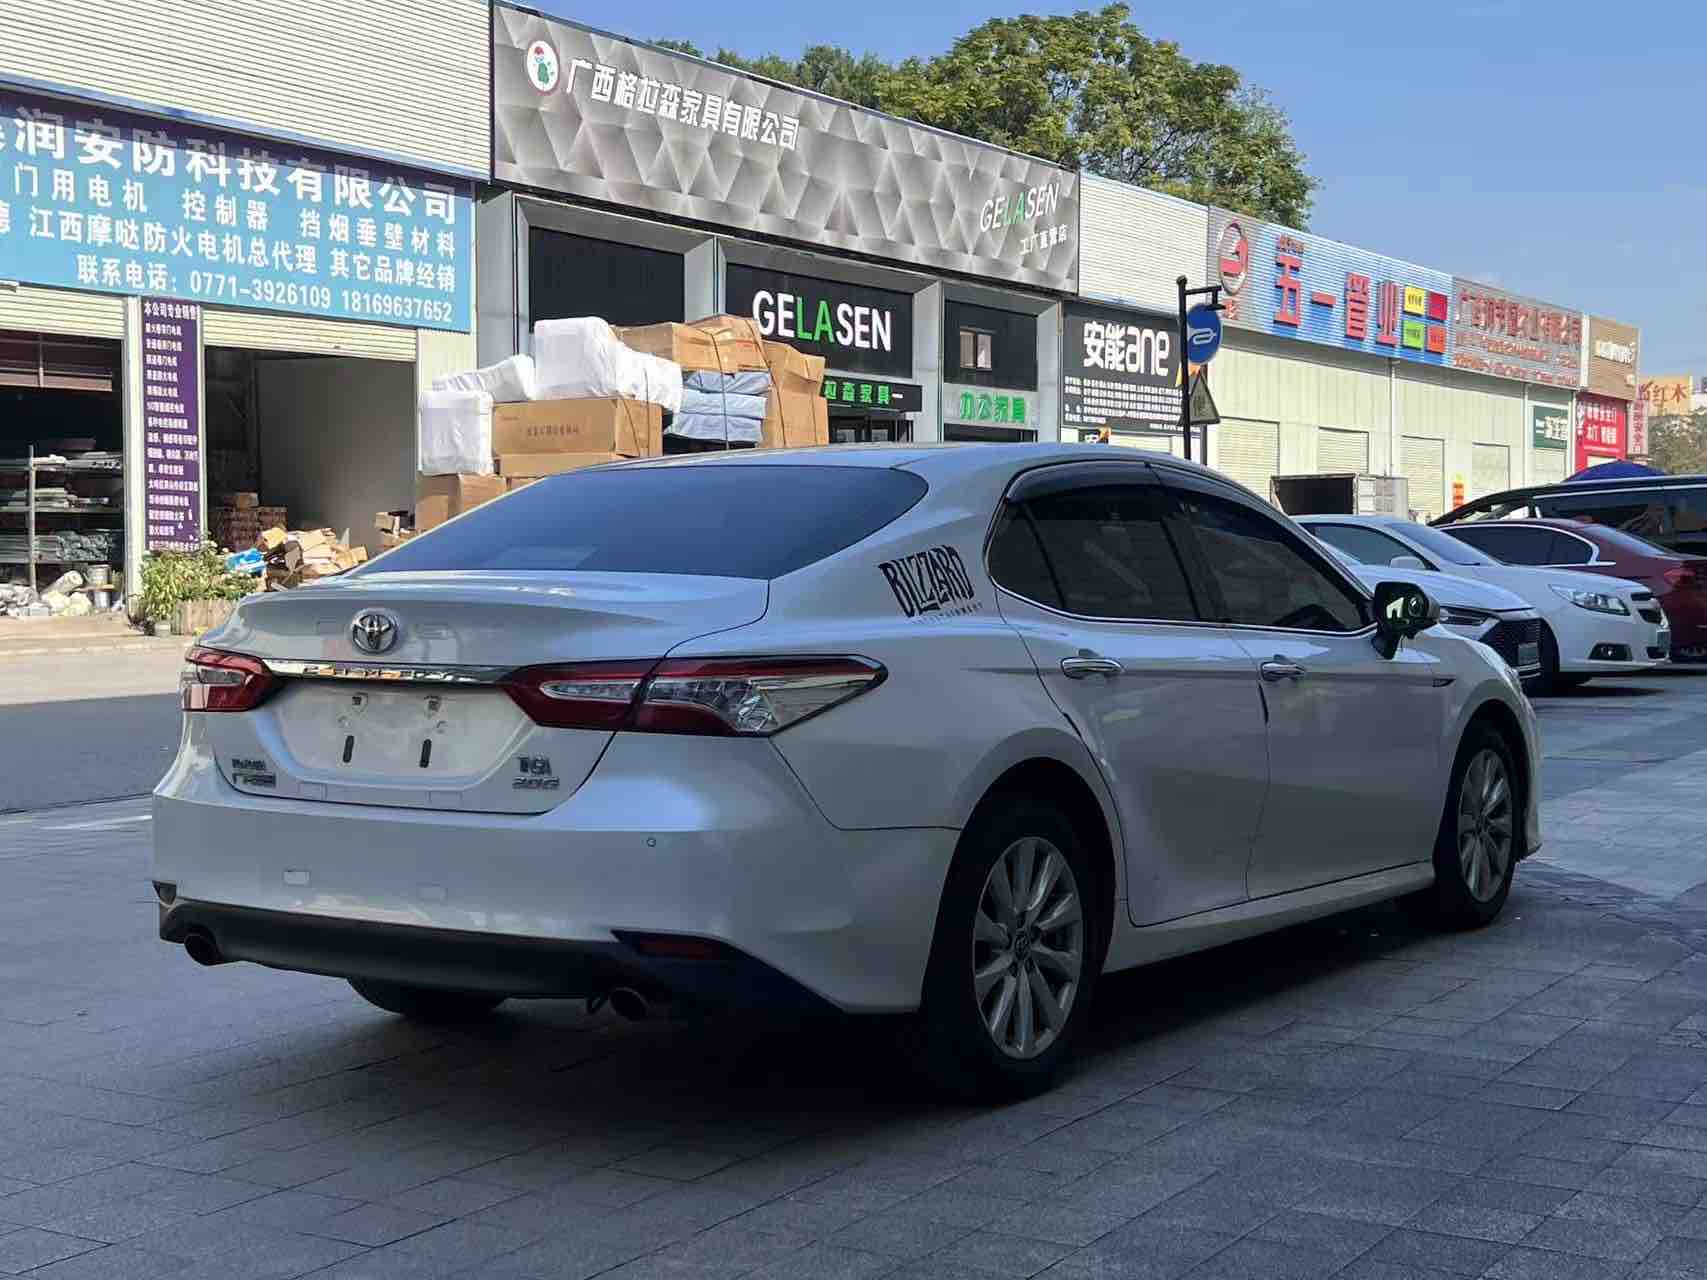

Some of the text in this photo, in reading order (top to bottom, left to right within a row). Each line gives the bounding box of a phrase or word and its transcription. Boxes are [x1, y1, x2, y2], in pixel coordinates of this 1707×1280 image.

[181, 188, 268, 231] 控制器
[980, 183, 1060, 232] GELASEN
[330, 247, 456, 293] 其它品牌经销
[190, 270, 332, 309] 0771-3926109
[342, 289, 454, 323] 18169637652
[752, 290, 893, 352] GELASEN
